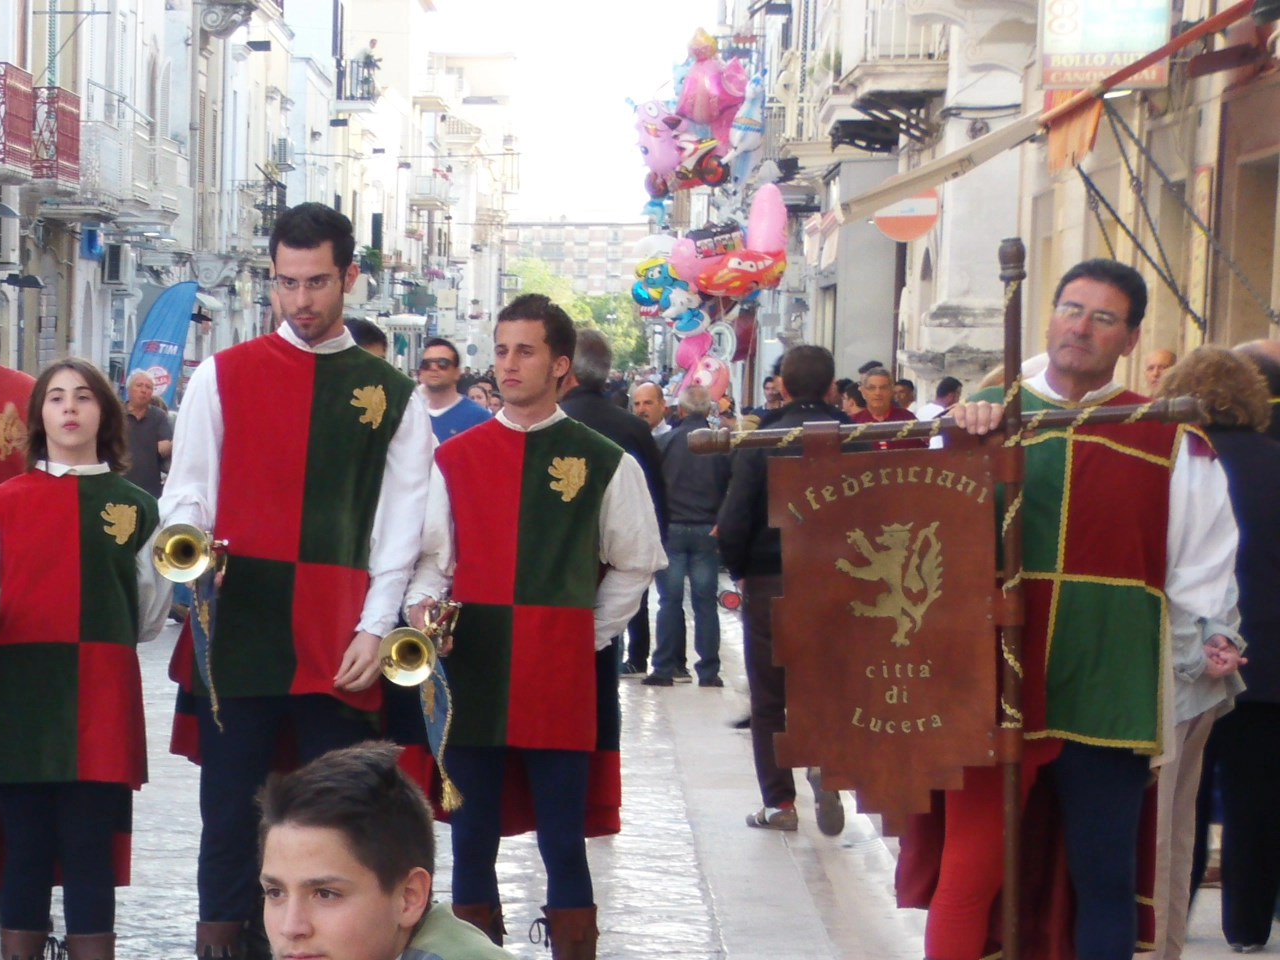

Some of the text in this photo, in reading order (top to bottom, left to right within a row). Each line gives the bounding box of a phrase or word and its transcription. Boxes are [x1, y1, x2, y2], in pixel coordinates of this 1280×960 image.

[1051, 53, 1106, 67] BOLLO
[159, 344, 178, 355] TIM
[805, 465, 989, 511] federiciani
[865, 659, 933, 679] città
[884, 685, 909, 704] di
[851, 706, 943, 734] Lucera
